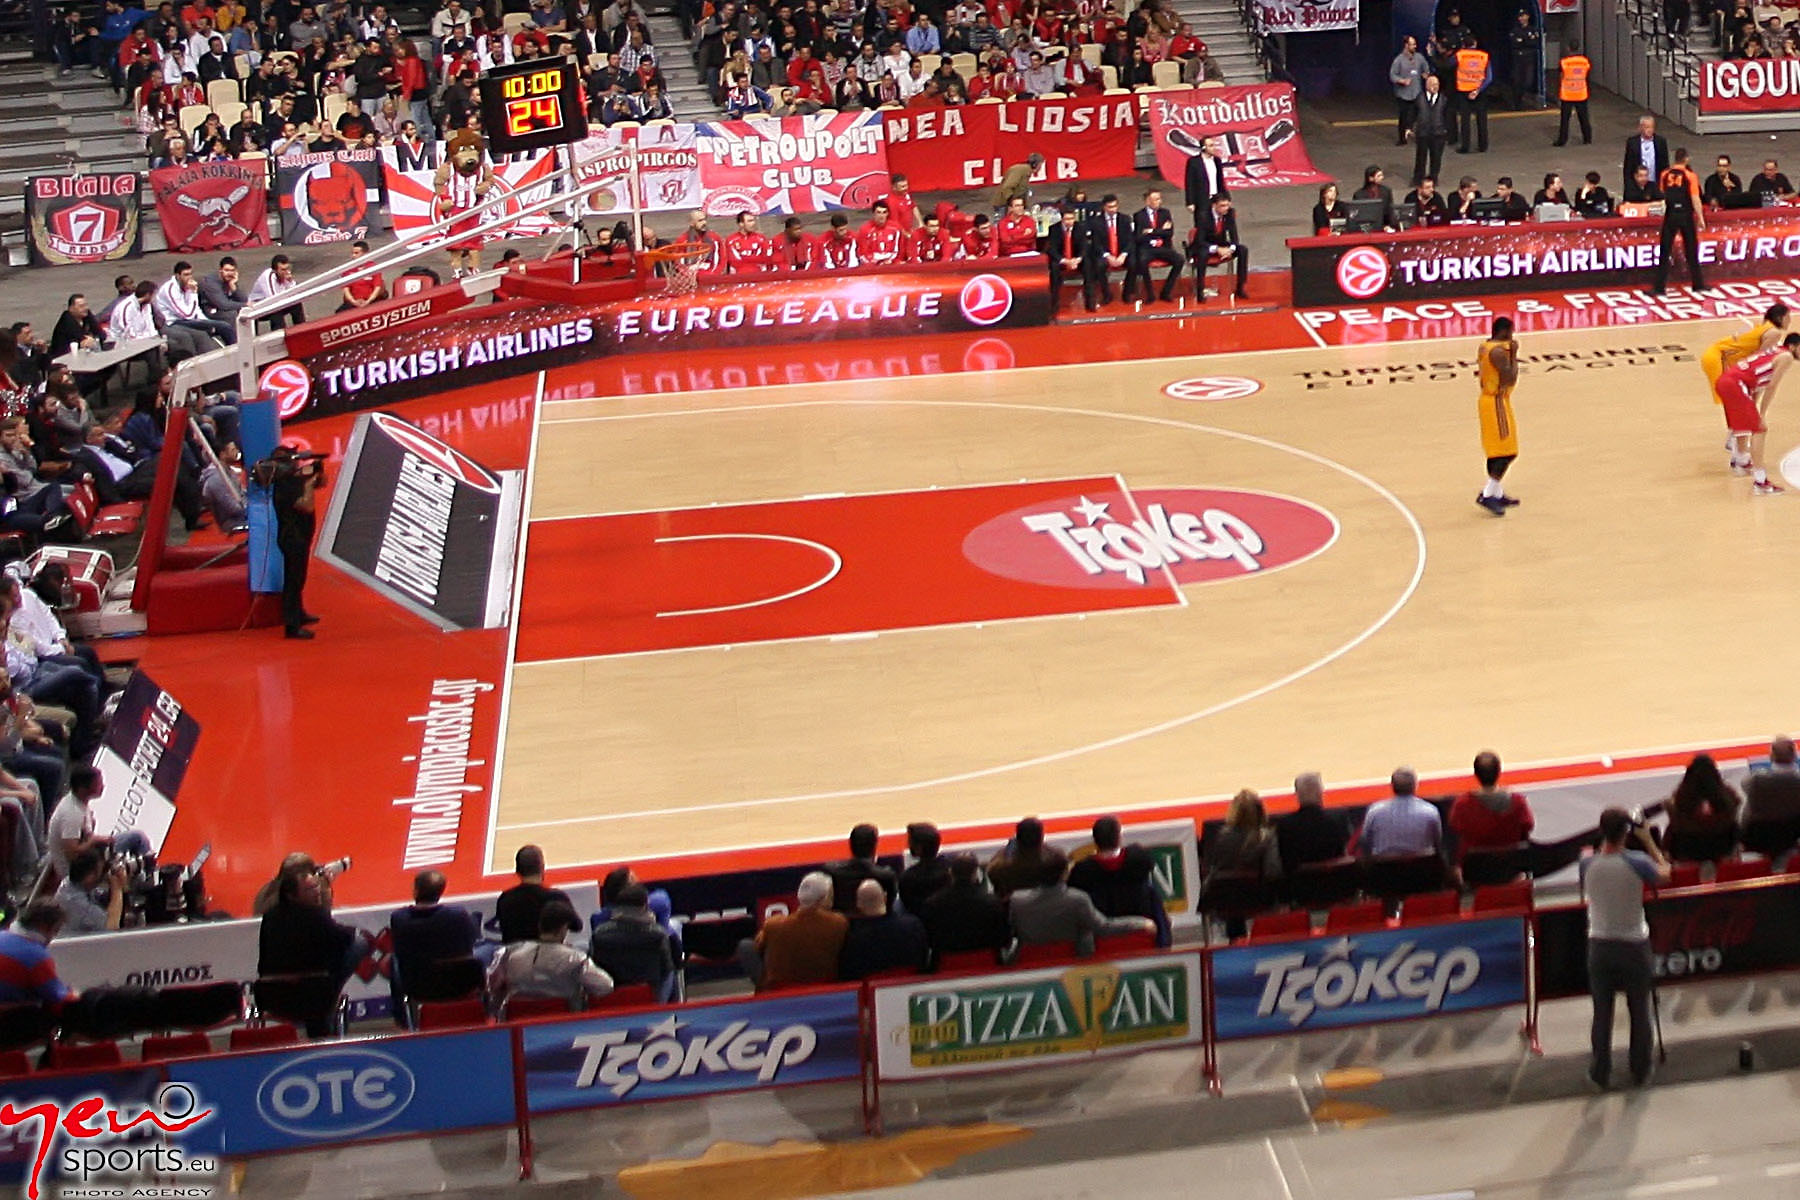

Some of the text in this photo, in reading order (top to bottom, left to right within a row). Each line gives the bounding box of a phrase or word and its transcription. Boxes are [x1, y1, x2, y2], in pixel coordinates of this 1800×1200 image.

[504, 70, 562, 99] 10:00
[511, 97, 557, 134] 24
[888, 101, 1136, 145] NEA LIOSIA
[762, 169, 833, 189] CLUB
[73, 213, 102, 244] 7
[1400, 251, 1536, 284] TURKISH
[618, 292, 942, 337] EUROLEAGUE
[1306, 300, 1494, 329] PEACE
[1515, 300, 1556, 314] &
[323, 317, 594, 397] TURKISH AIRLINES
[391, 678, 495, 870] www.olympiacosbc.gr
[916, 988, 1070, 1050] PIZZA
